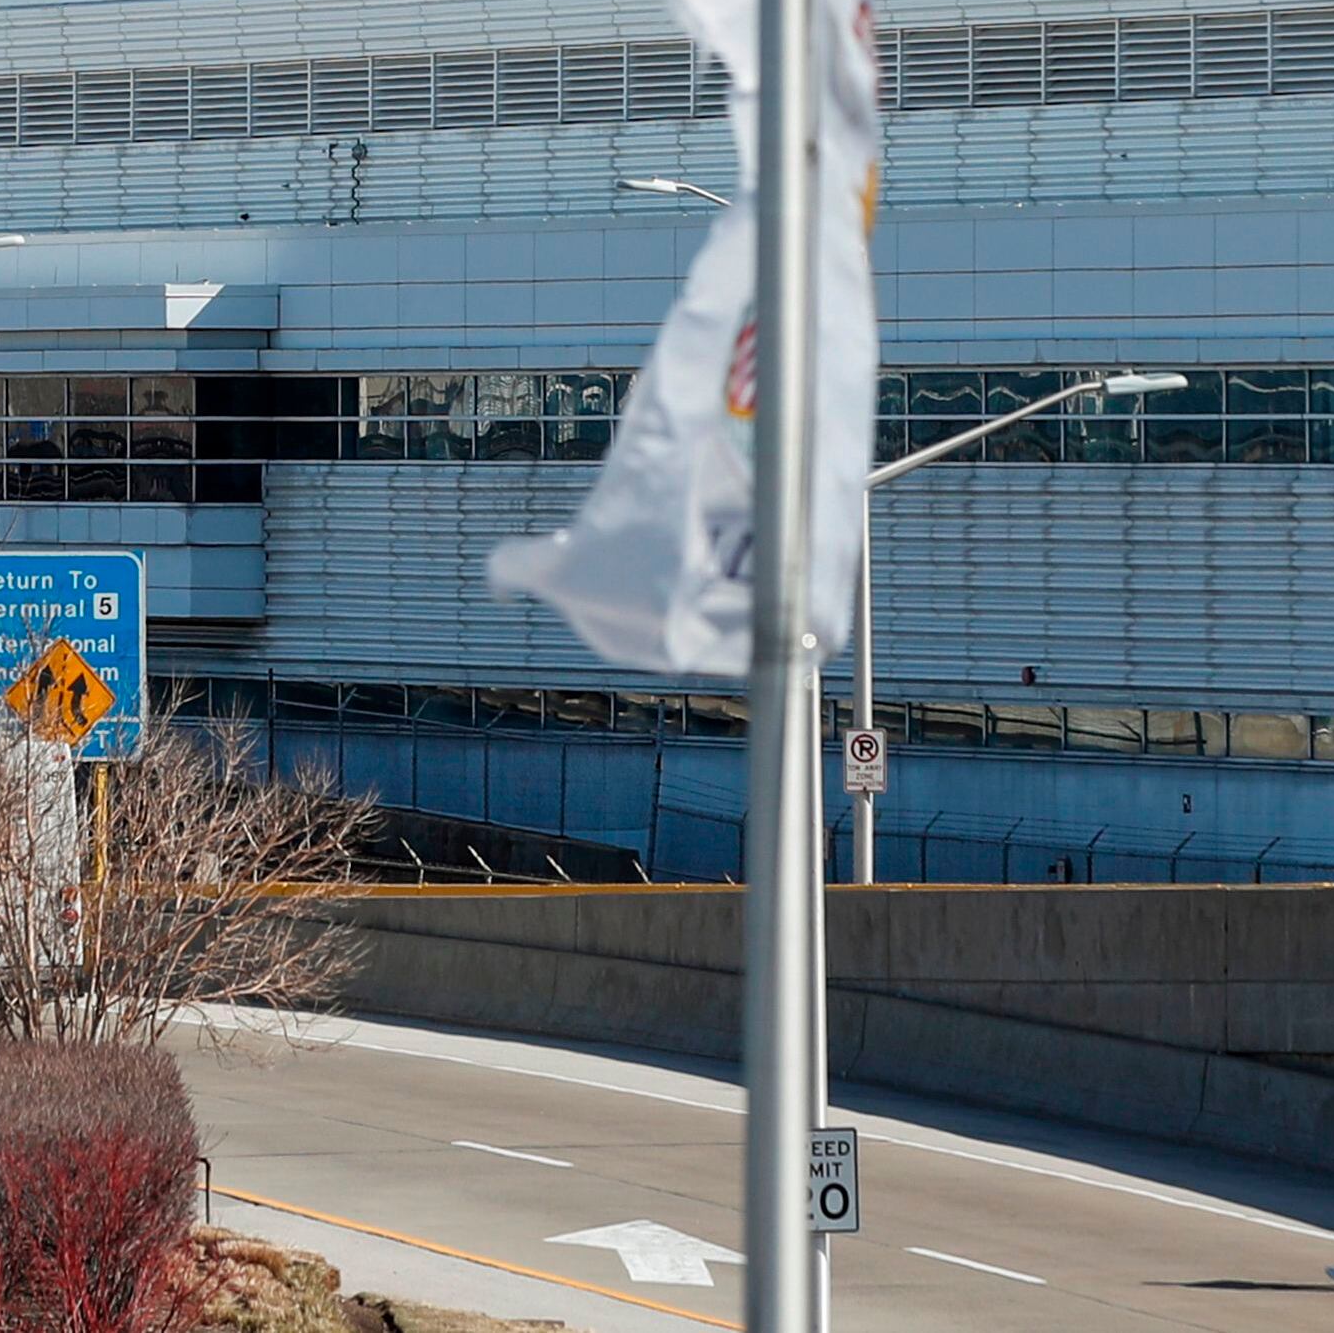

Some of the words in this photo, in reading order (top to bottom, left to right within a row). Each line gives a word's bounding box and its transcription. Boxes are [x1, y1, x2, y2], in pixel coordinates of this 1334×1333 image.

[69, 570, 98, 589] To
[99, 597, 112, 615] 5
[810, 1140, 851, 1156] EED
[809, 1161, 843, 1178] MIT
